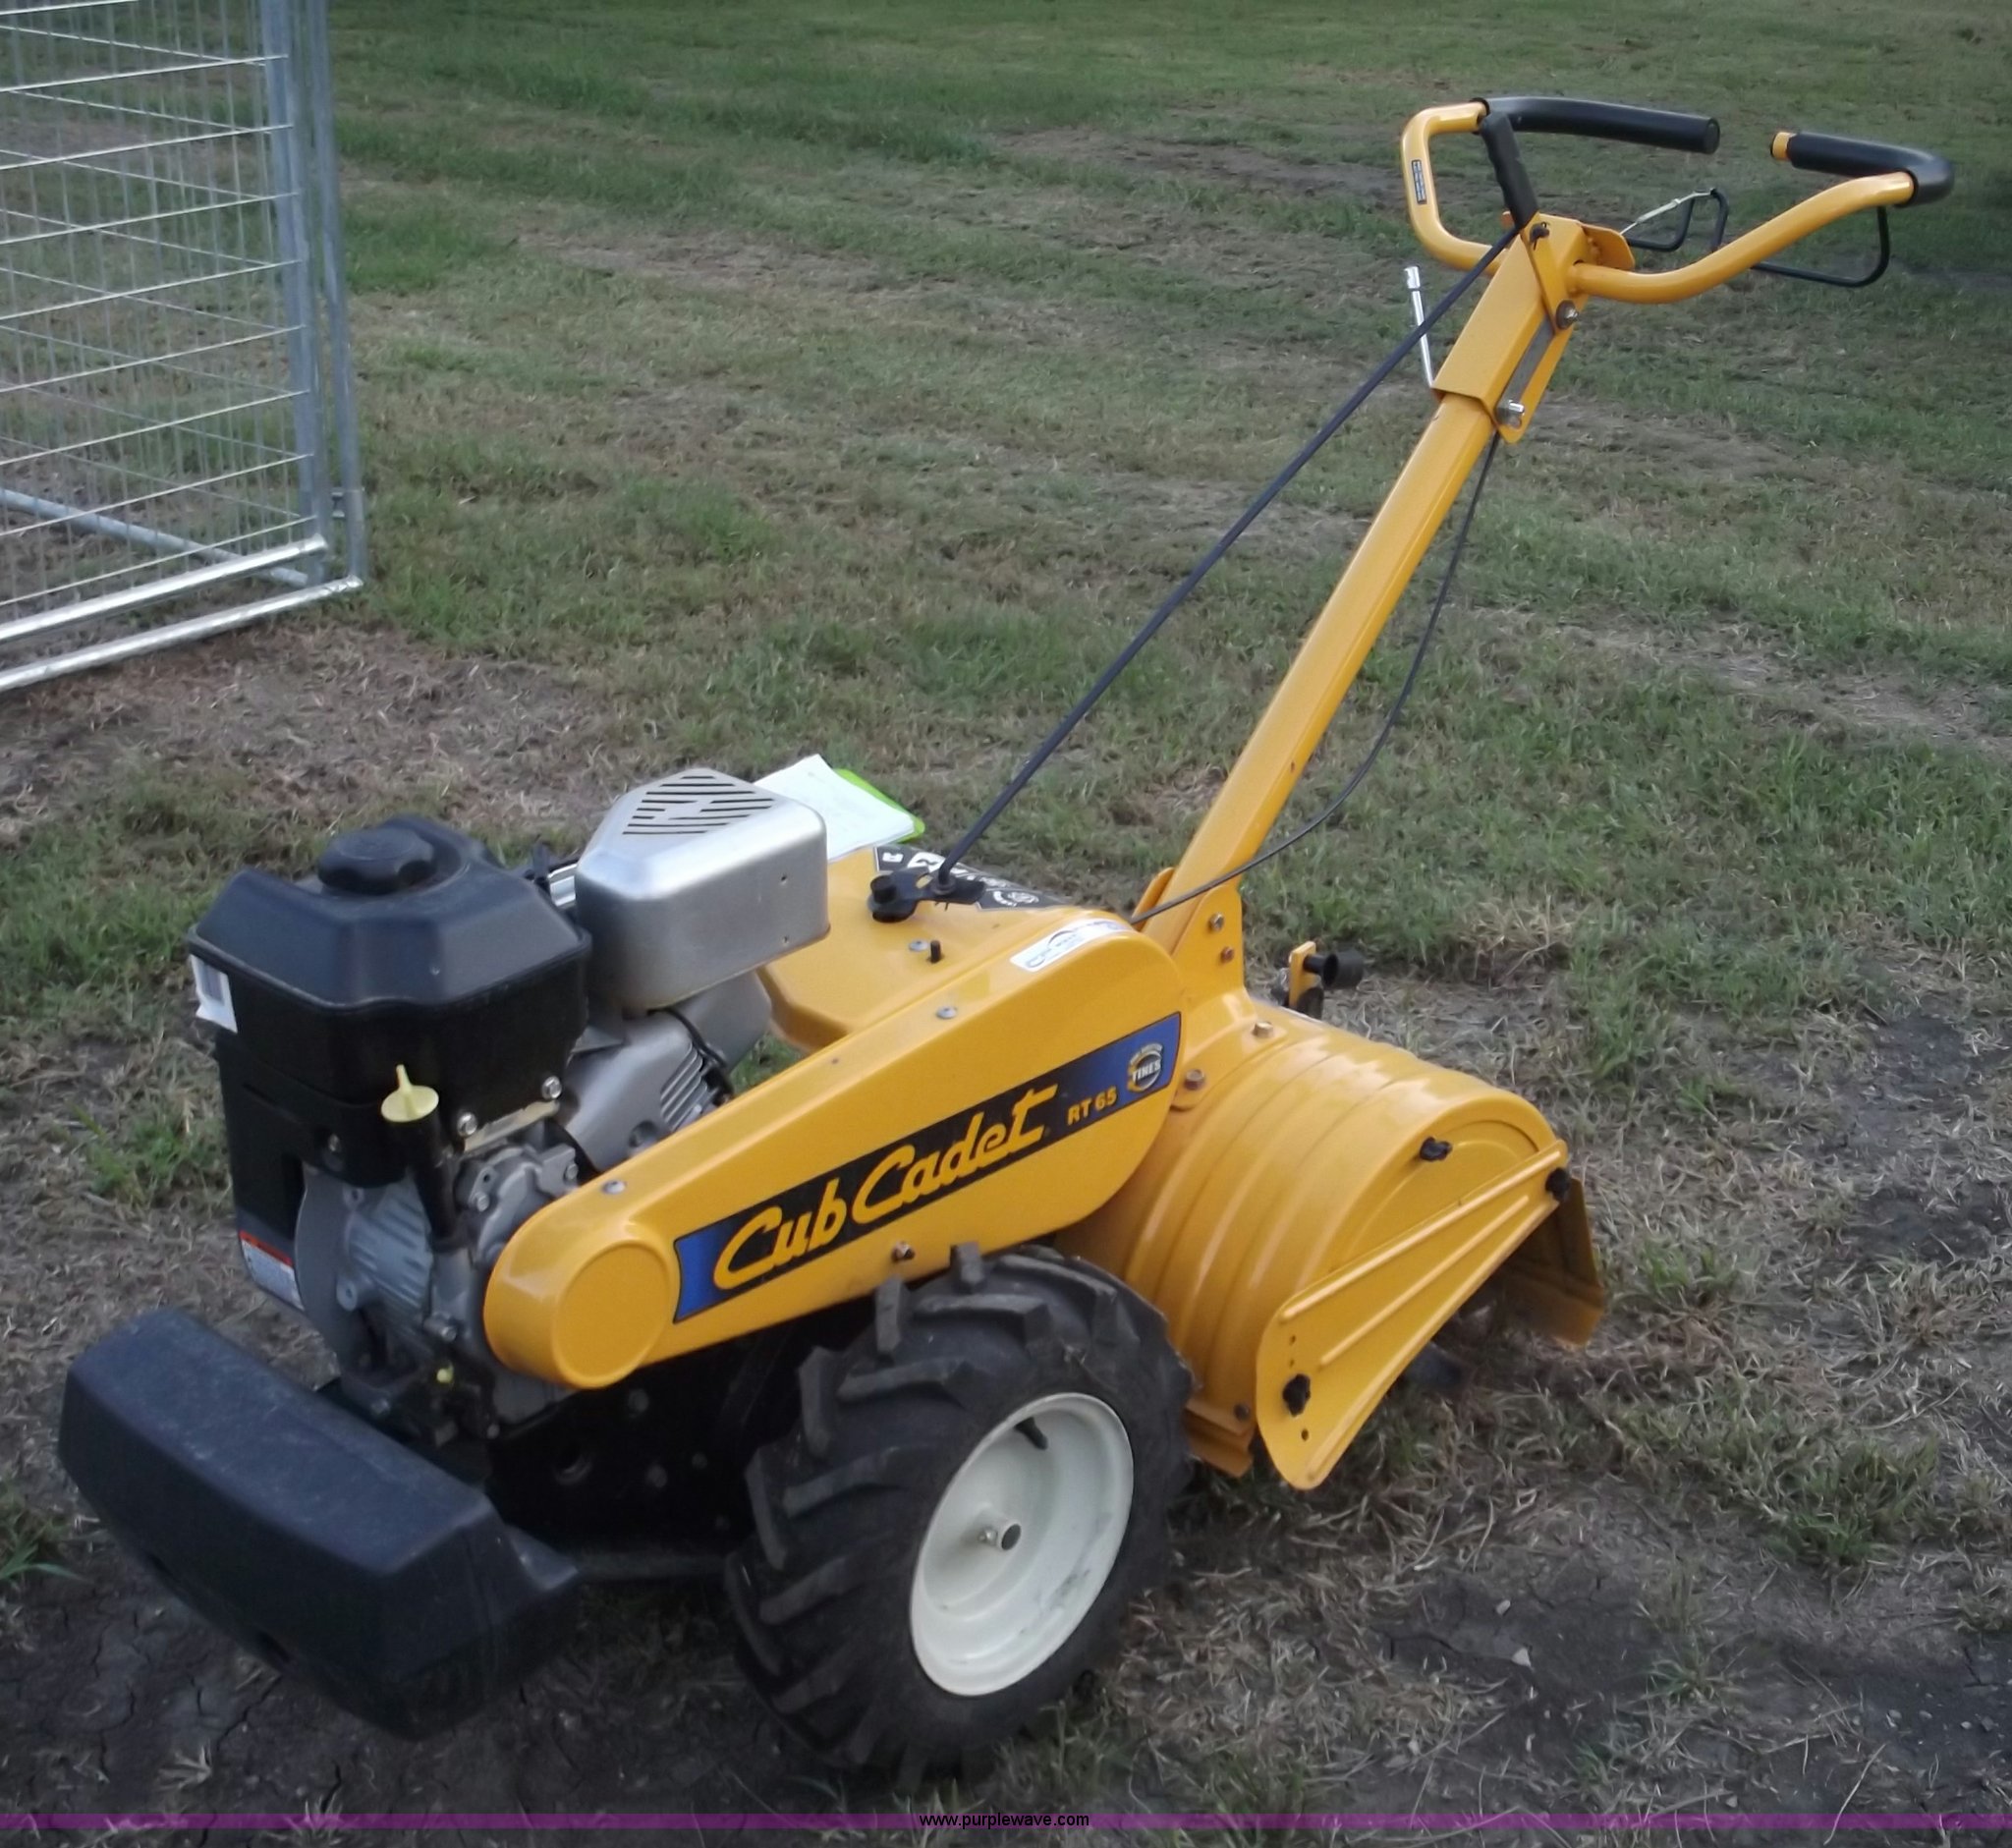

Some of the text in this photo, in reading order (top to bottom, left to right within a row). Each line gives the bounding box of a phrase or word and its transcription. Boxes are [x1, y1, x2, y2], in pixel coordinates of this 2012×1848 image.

[1067, 1086, 1117, 1126] RT 65
[713, 1084, 1057, 1290] Cub Cadet
